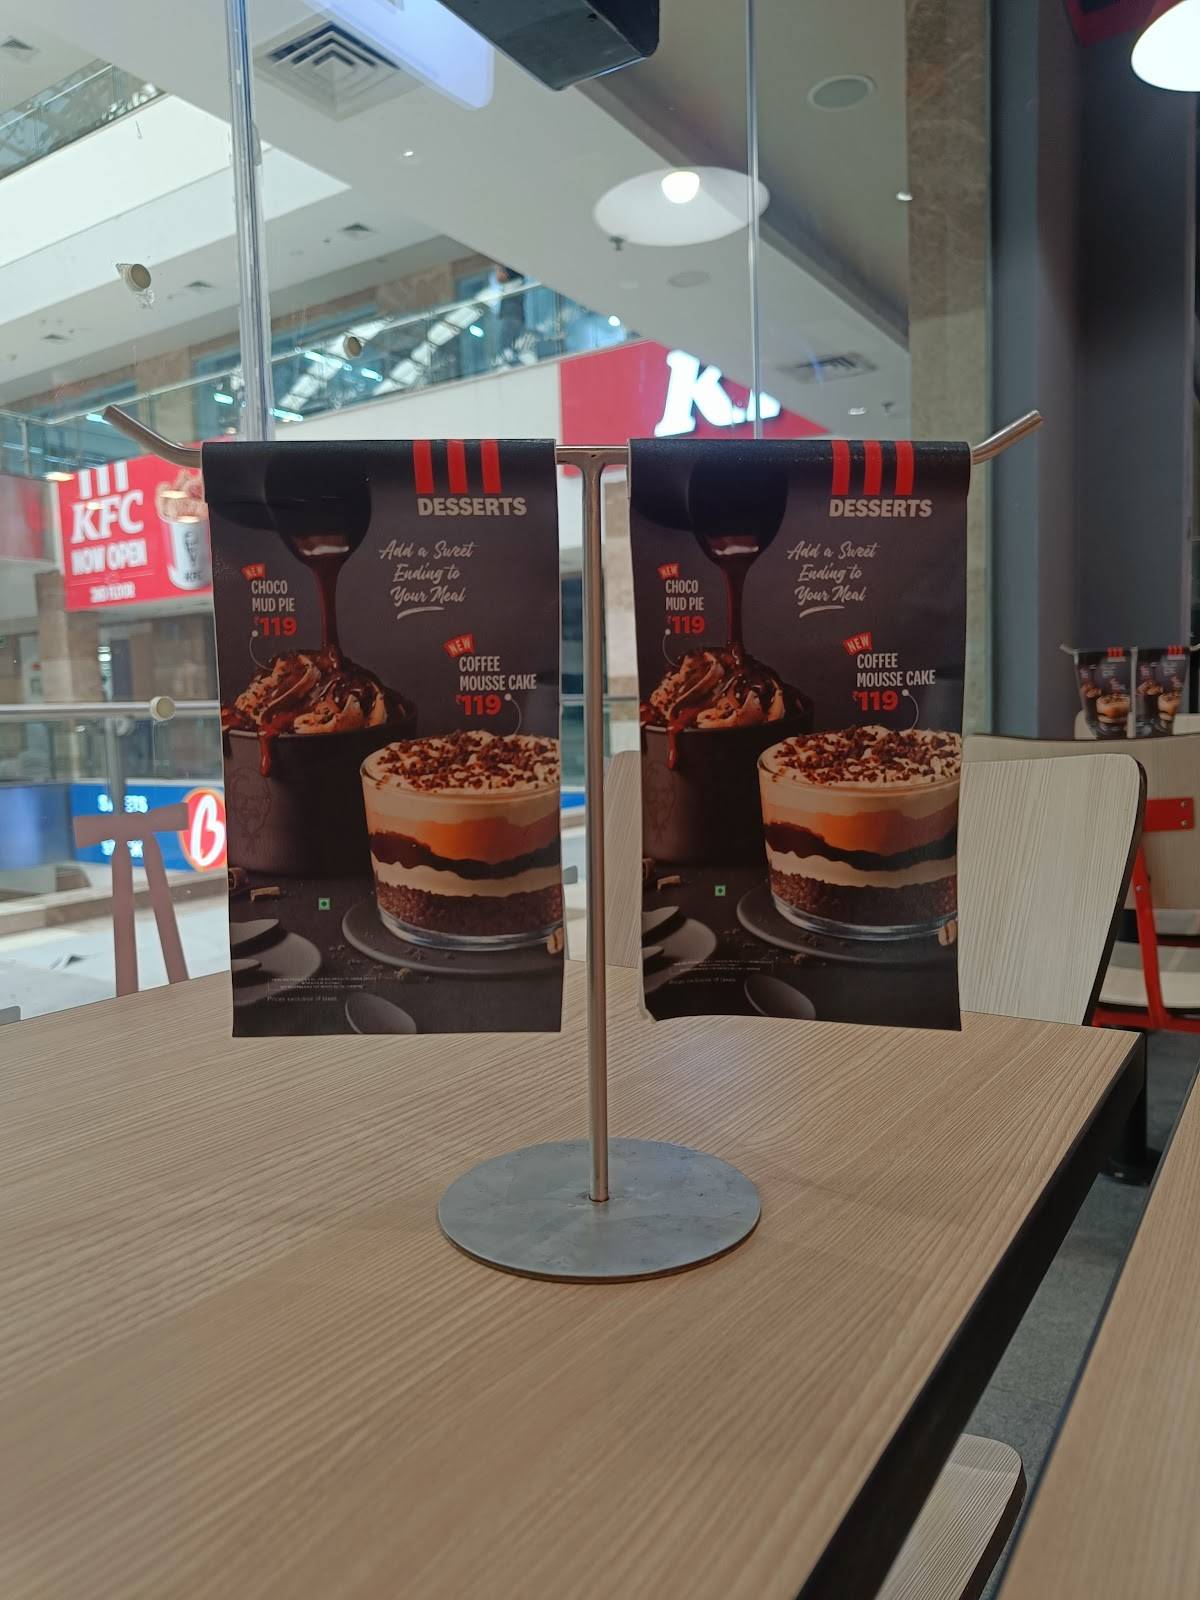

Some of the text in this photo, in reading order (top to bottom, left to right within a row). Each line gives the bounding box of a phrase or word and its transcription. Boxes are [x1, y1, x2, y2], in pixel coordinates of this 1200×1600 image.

[417, 497, 527, 516] DESSERTS
[829, 499, 933, 518] DESSERTS
[70, 489, 144, 544] KFC
[106, 538, 148, 571] OPEN
[379, 539, 478, 560] Add a Sweet
[787, 540, 880, 560] Add a Sweet
[393, 562, 461, 584] Ending to
[798, 562, 862, 584] Ending to
[251, 580, 288, 594] CHOCO
[390, 585, 466, 607] Your Meal
[665, 580, 699, 594] CHOCO
[794, 585, 867, 606] Your Meal
[252, 597, 296, 612] MUD PIE
[665, 596, 704, 611] MUD PIE
[447, 637, 471, 654] NEW
[847, 635, 870, 653] NEW
[459, 656, 501, 672] COFFEE
[857, 653, 899, 669] COFFEE
[460, 673, 537, 691] MOUSSE CAKE
[857, 669, 936, 688] MOUSSE CAKE
